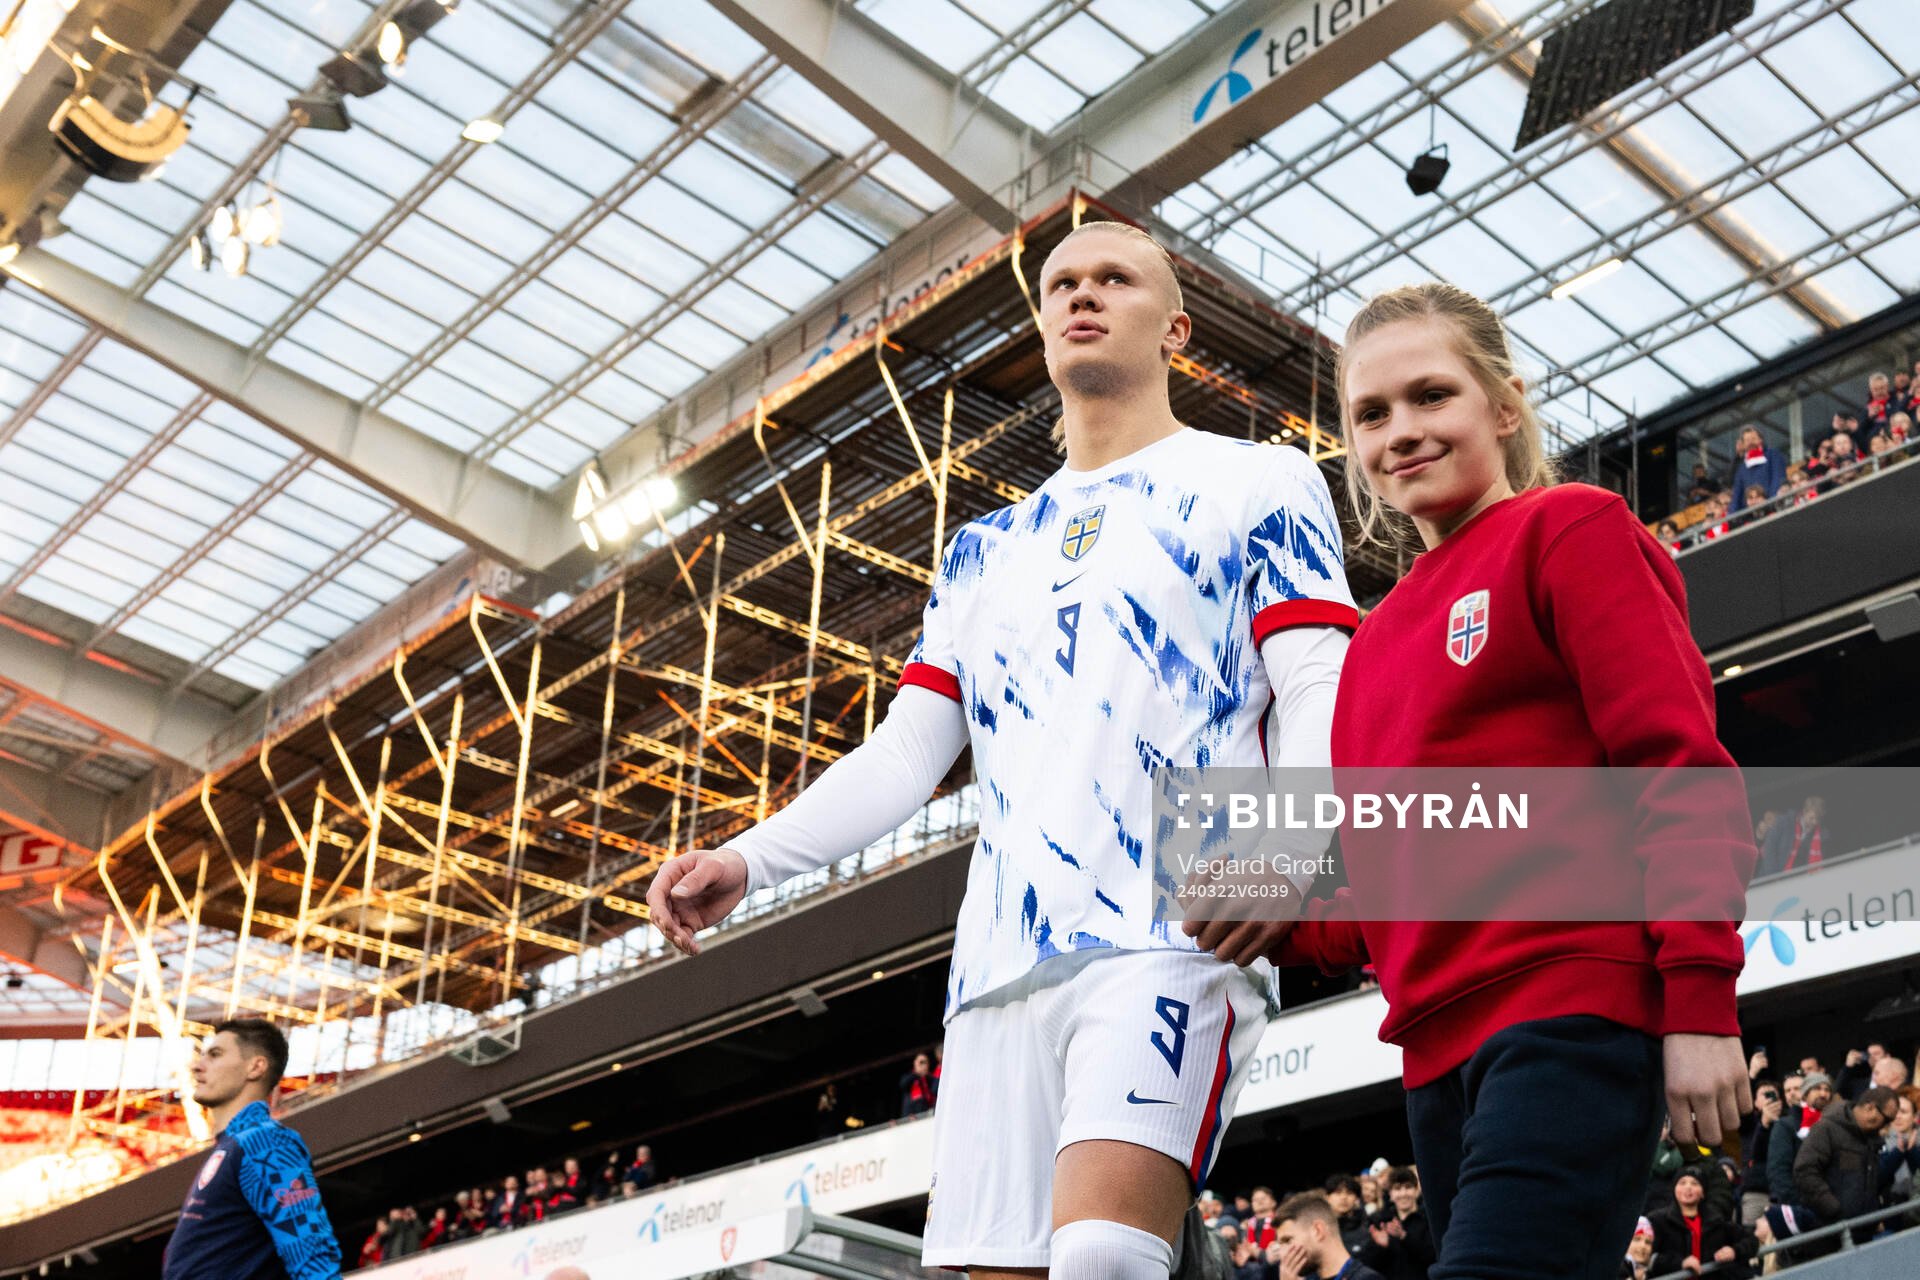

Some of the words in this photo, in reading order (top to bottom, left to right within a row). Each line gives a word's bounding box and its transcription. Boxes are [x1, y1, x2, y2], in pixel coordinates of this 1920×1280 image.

[1055, 601, 1082, 678] 9
[1150, 995, 1190, 1079] 9
[814, 1157, 886, 1194] telenor
[663, 1199, 726, 1234] telenor
